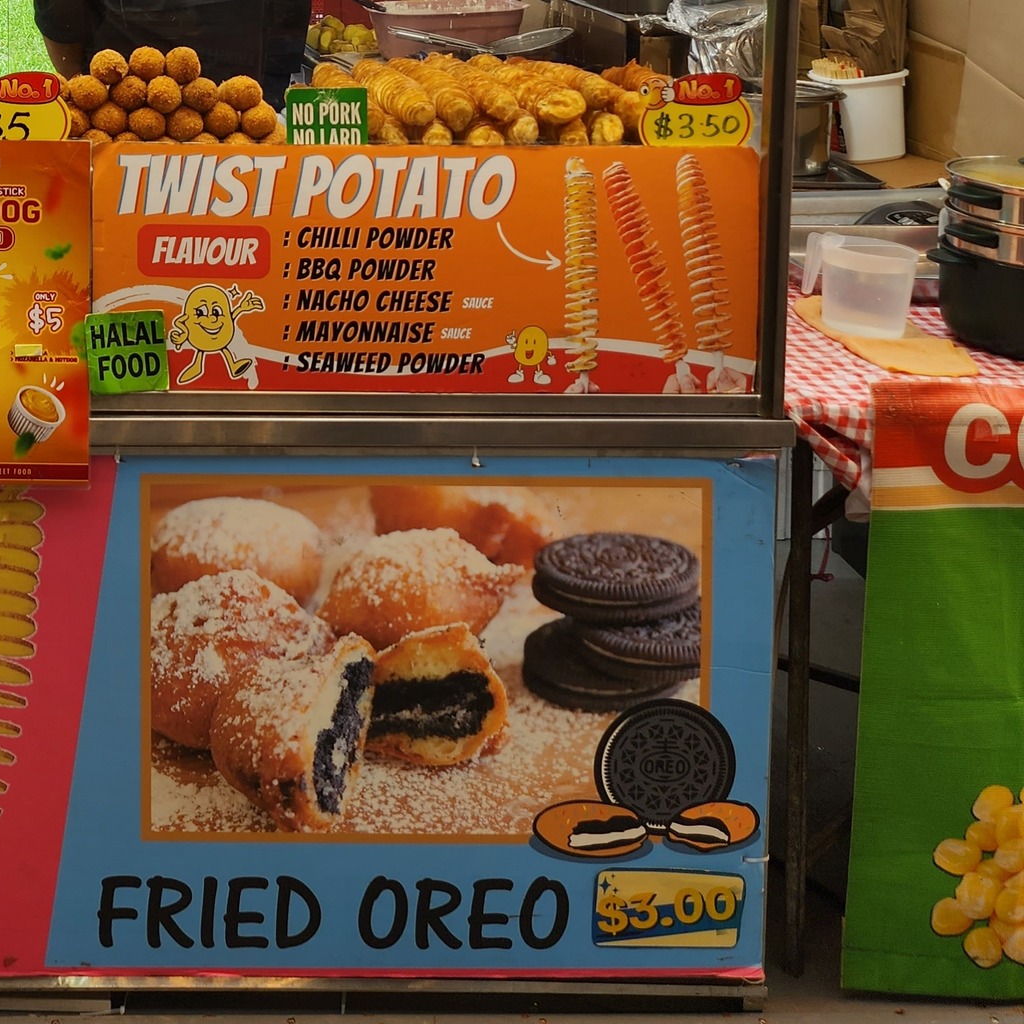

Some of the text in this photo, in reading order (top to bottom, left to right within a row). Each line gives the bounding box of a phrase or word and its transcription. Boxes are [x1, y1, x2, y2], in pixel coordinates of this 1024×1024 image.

[0, 78, 53, 98] No. 1
[678, 79, 734, 100] No. 1
[292, 102, 361, 125] NO PORK
[117, 154, 516, 219] TWIST POTATO
[151, 236, 259, 265] FLAVOUR
[296, 227, 454, 250] CHILLI POWDER
[296, 258, 436, 281] BBQ POWDER
[296, 289, 494, 313] NACHO CHEESE SAUCE
[28, 304, 62, 333] $5
[91, 321, 164, 350] HALAL
[295, 321, 472, 344] MAYONNAISE SAUCE
[98, 352, 160, 381] FOOD
[295, 351, 485, 375] SEAWEED POWDER
[97, 875, 570, 951] FRIED OREO
[597, 886, 737, 936] $3.00
